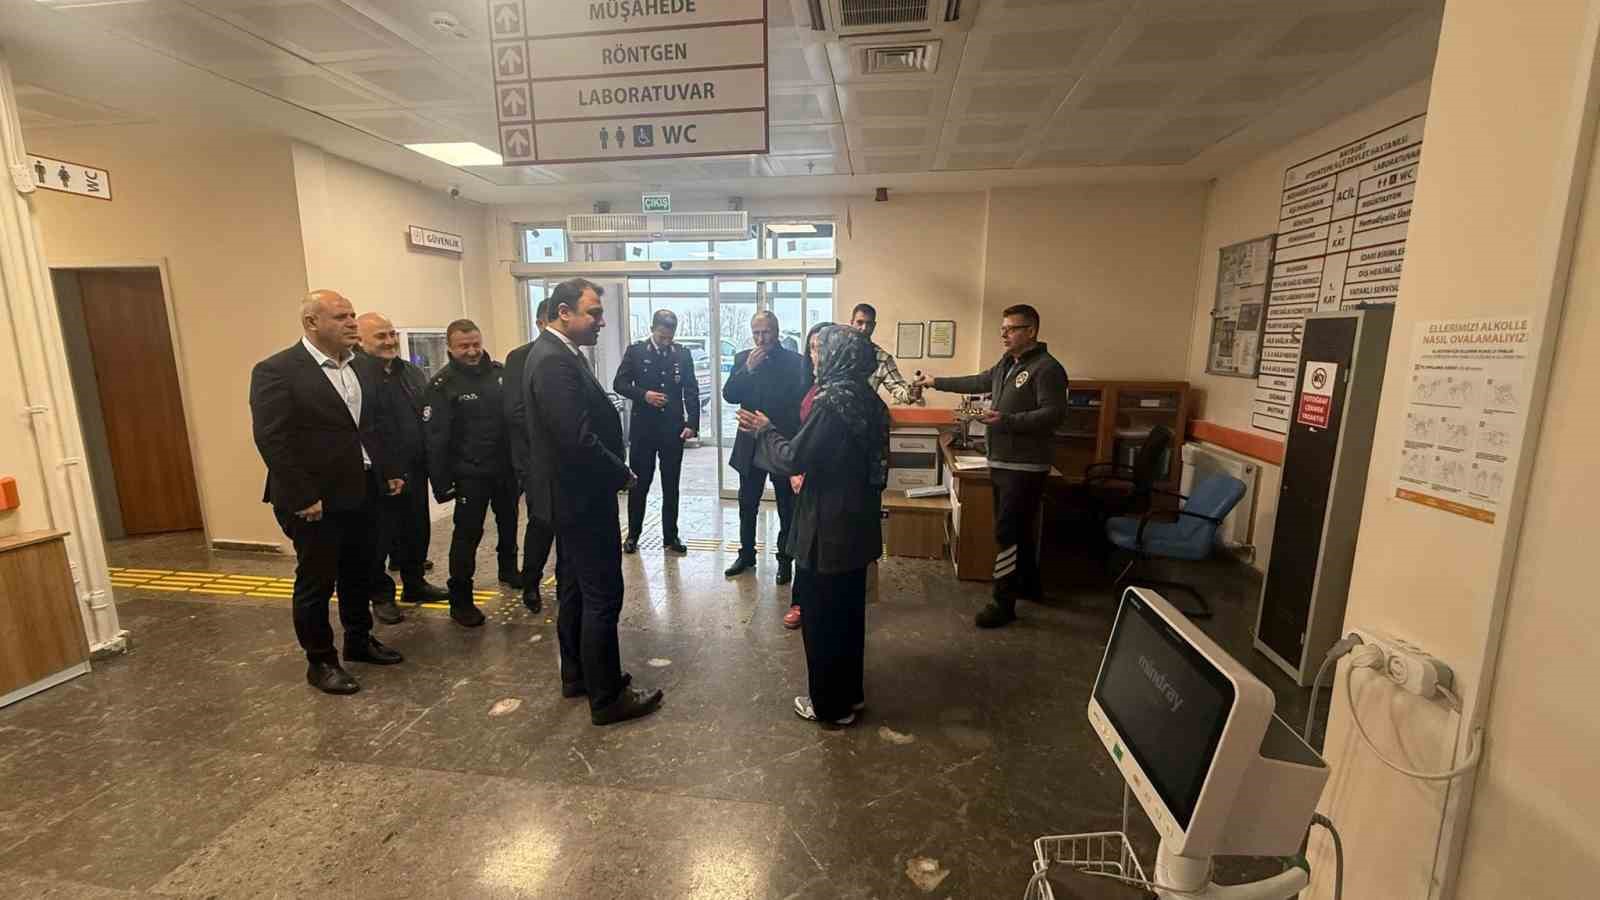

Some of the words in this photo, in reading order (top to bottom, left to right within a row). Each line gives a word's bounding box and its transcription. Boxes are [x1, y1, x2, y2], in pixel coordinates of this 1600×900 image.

[589, 0, 697, 23] MÜŞAHEDE
[602, 42, 688, 65] RÖNTGEN
[578, 82, 715, 106] LABORATUVAR
[662, 124, 697, 144] WC
[85, 170, 100, 193] WC
[1400, 169, 1414, 181] WC
[1336, 186, 1355, 202] ACİL
[1332, 237, 1345, 247] KAT
[1323, 295, 1336, 304] KAT
[1480, 319, 1528, 332] ALKOLLE
[1423, 335, 1447, 345] NASIL
[1137, 655, 1184, 712] mindray
